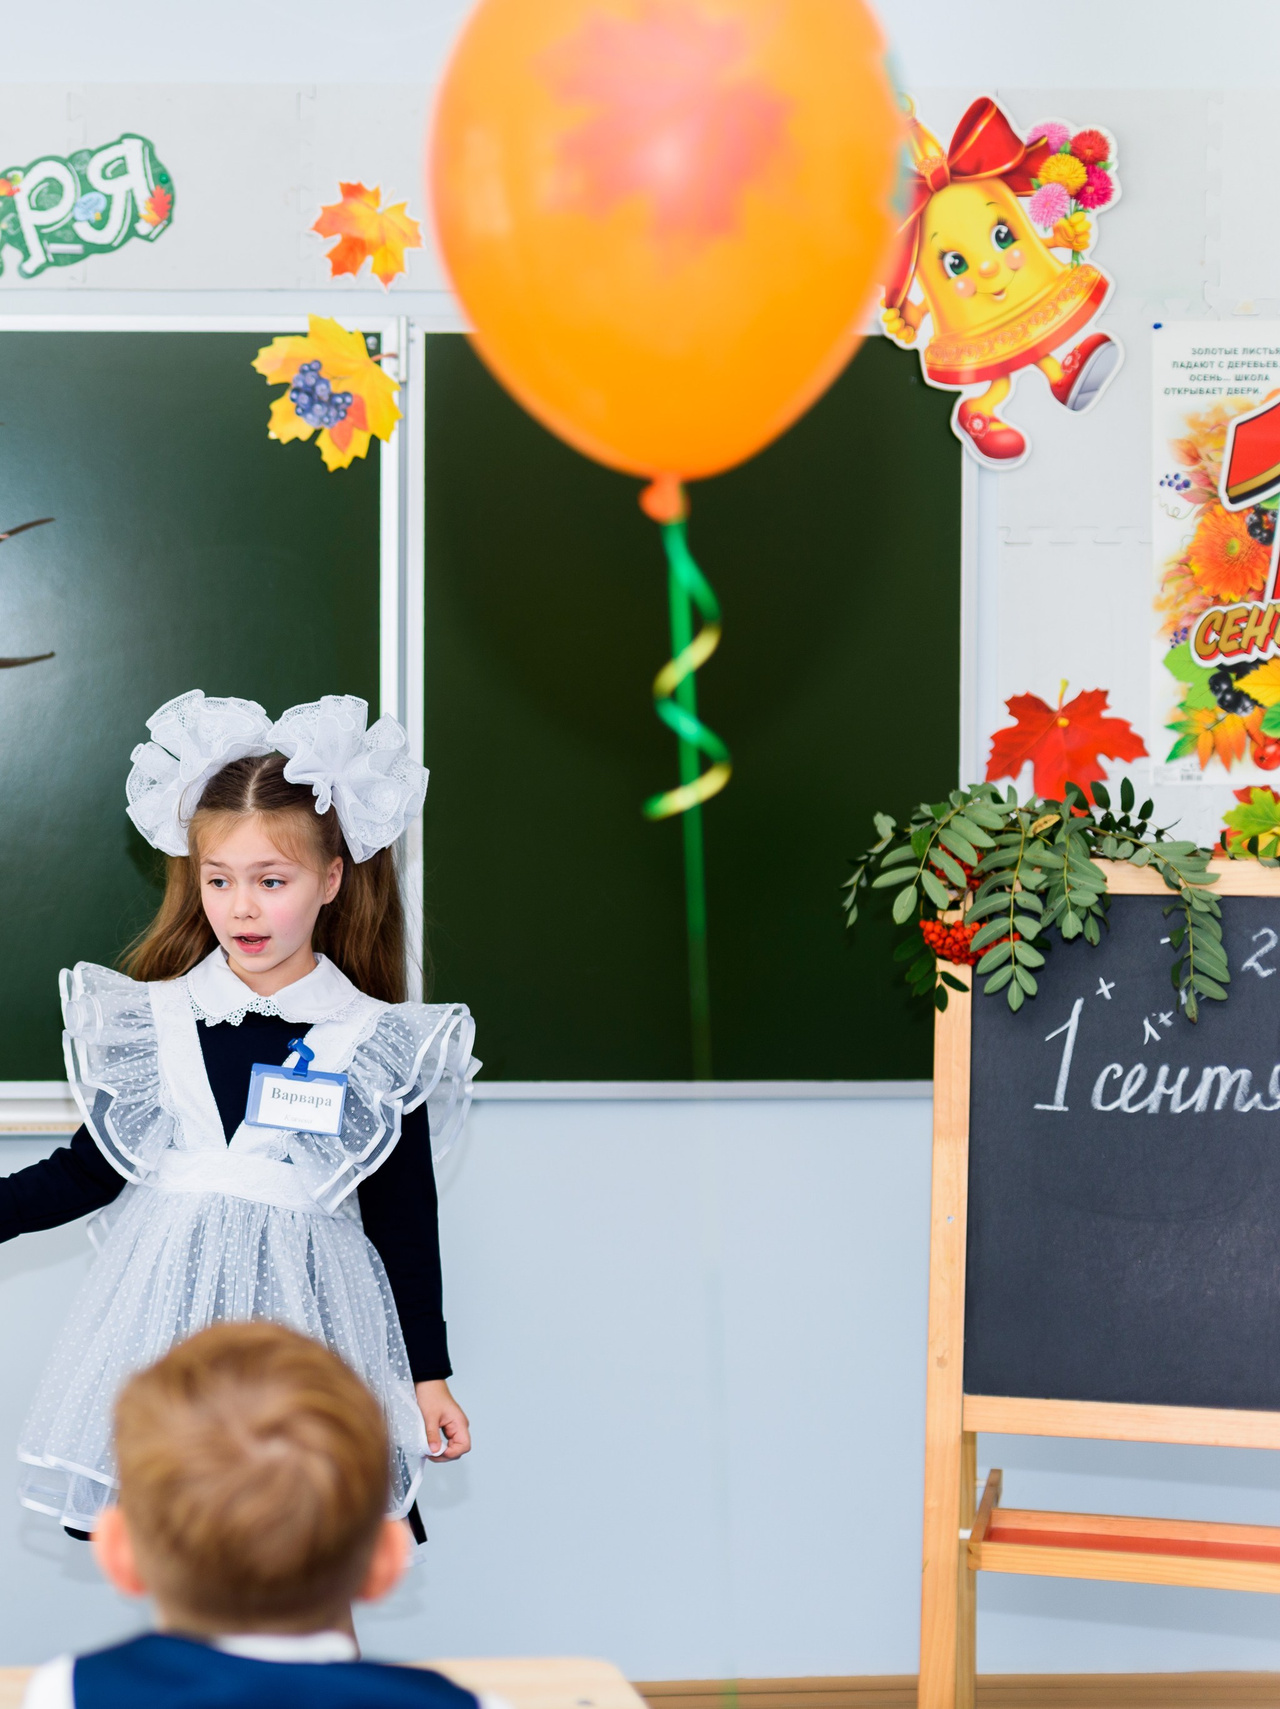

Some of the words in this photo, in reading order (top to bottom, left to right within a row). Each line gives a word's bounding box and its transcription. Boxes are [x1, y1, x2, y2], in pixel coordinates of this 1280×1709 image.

[1191, 347, 1239, 355] ЗОЛОТЫЕ
[1242, 347, 1280, 355] ЛИСТЬЯ
[1172, 360, 1215, 369] ПАДАЮТ
[1164, 387, 1224, 395] ОТКРЫВАЕТ
[1033, 997, 1084, 1112] 1
[271, 1087, 332, 1108] Варвара
